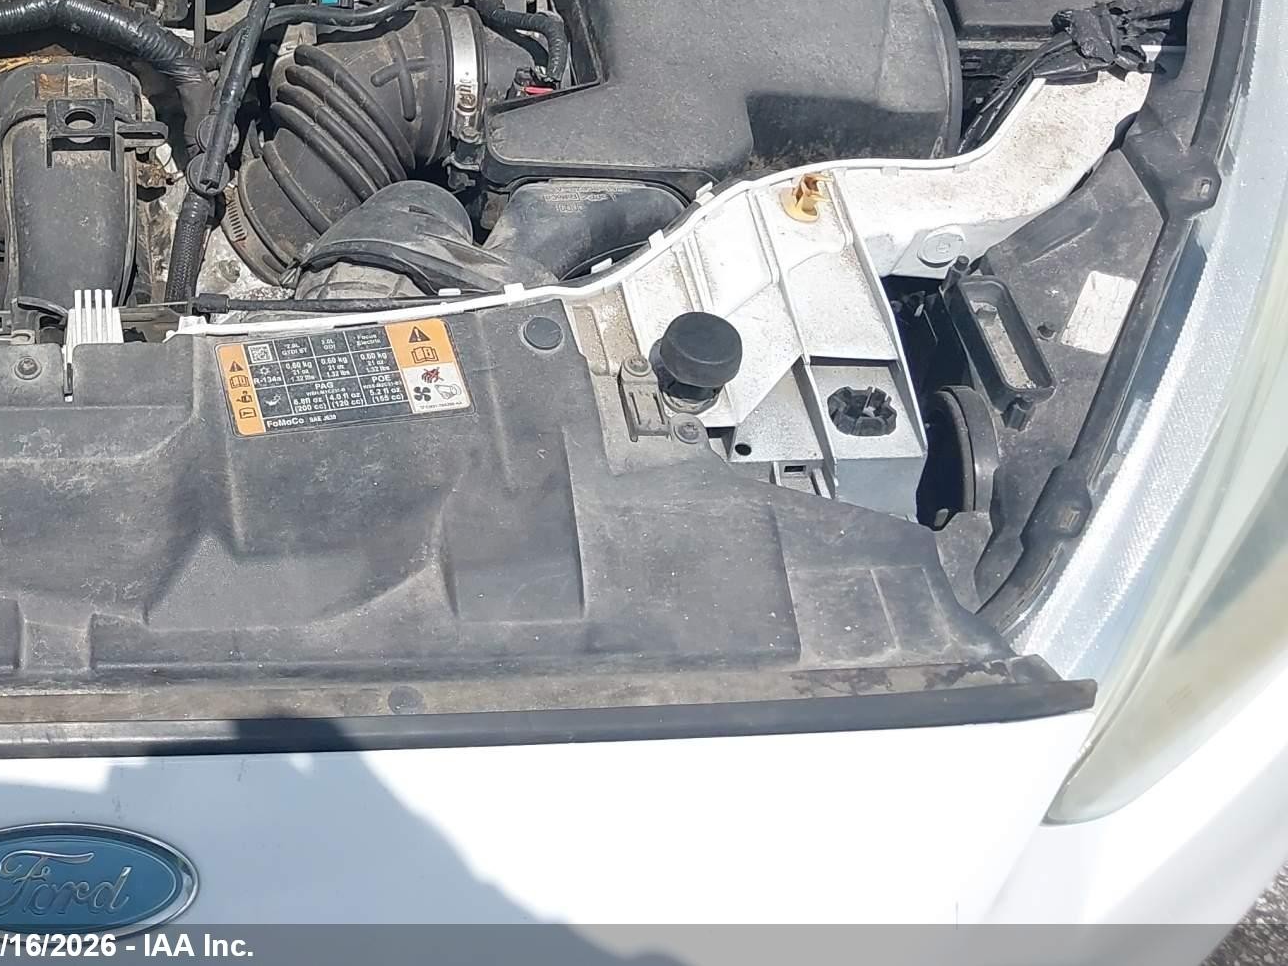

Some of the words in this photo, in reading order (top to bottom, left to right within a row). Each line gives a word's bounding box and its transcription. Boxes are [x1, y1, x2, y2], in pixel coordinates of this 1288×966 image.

[371, 374, 392, 382] POE
[314, 381, 334, 389] PAG
[266, 416, 305, 428] FoMoCo
